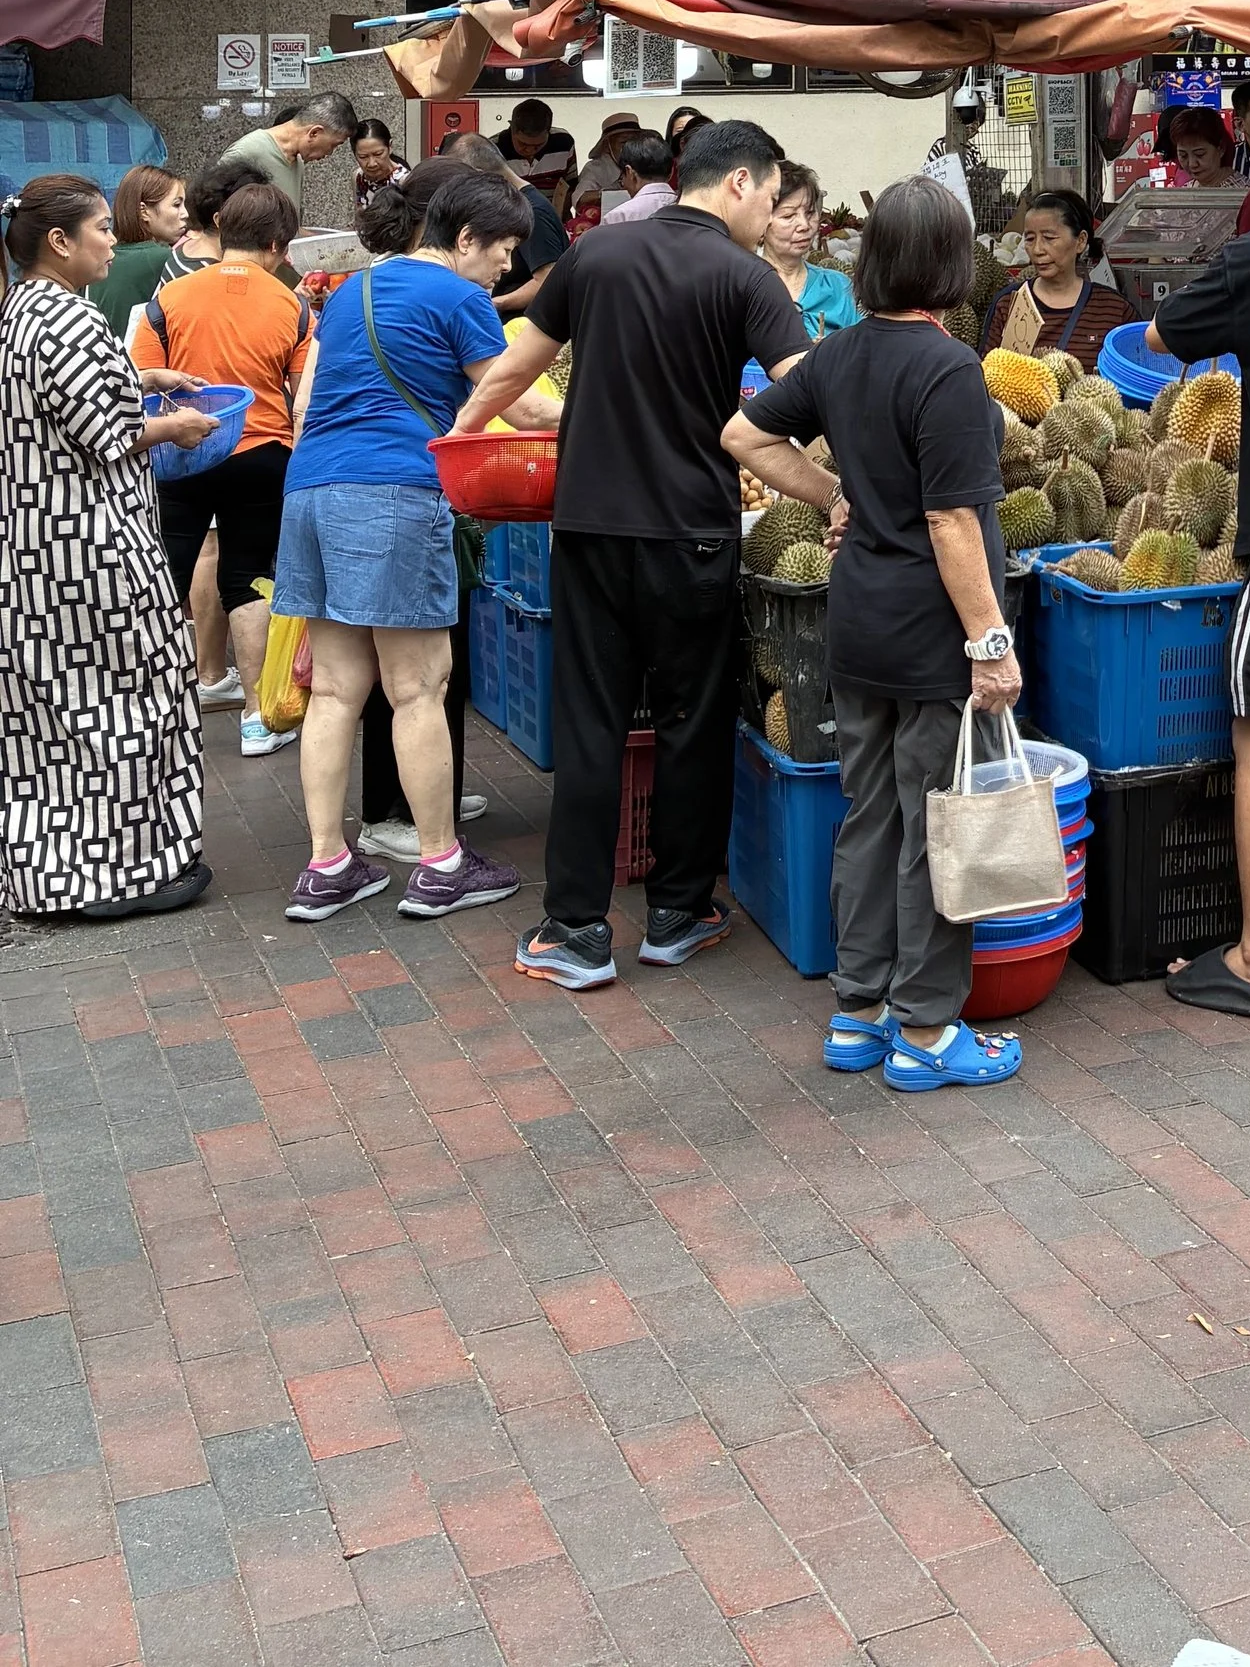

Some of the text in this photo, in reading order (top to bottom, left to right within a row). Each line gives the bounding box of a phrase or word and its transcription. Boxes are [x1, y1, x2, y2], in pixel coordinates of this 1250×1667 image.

[274, 42, 304, 51] NOTICE
[1007, 95, 1023, 106] CCTV
[1157, 285, 1166, 296] 9
